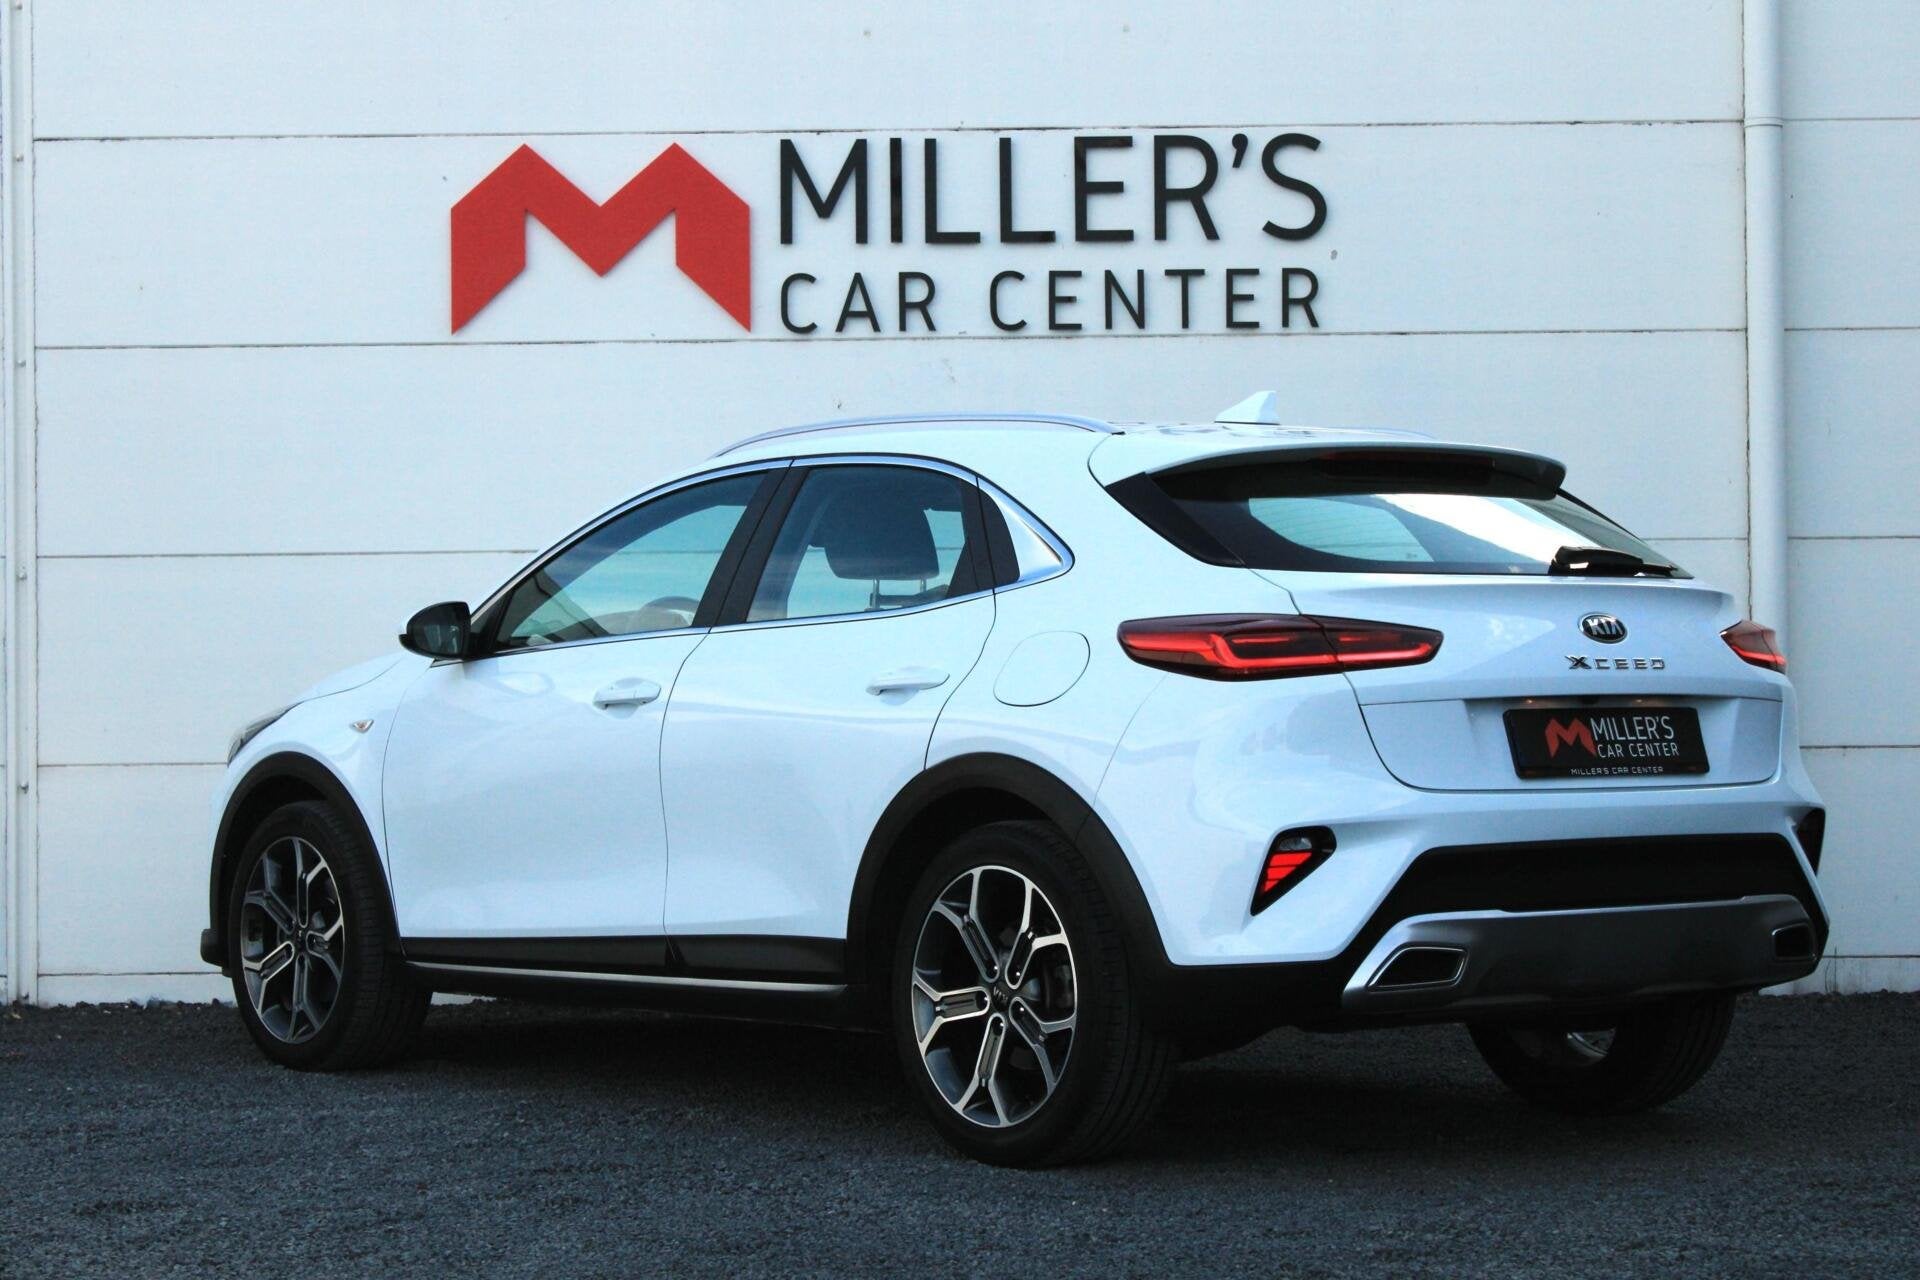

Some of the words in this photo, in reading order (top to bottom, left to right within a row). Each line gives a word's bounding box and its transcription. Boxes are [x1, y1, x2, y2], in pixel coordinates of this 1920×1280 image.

[779, 132, 1328, 245] MILLER'S
[780, 271, 937, 334] CAR
[989, 266, 1320, 332] CENTER
[1585, 617, 1624, 636] KIA
[1564, 655, 1665, 670] XCEED
[1590, 716, 1675, 741] MILLER'S
[1597, 744, 1625, 758] CAR
[1628, 742, 1680, 757] CENTER
[1612, 767, 1629, 775] CAR
[1631, 766, 1664, 774] CENTER
